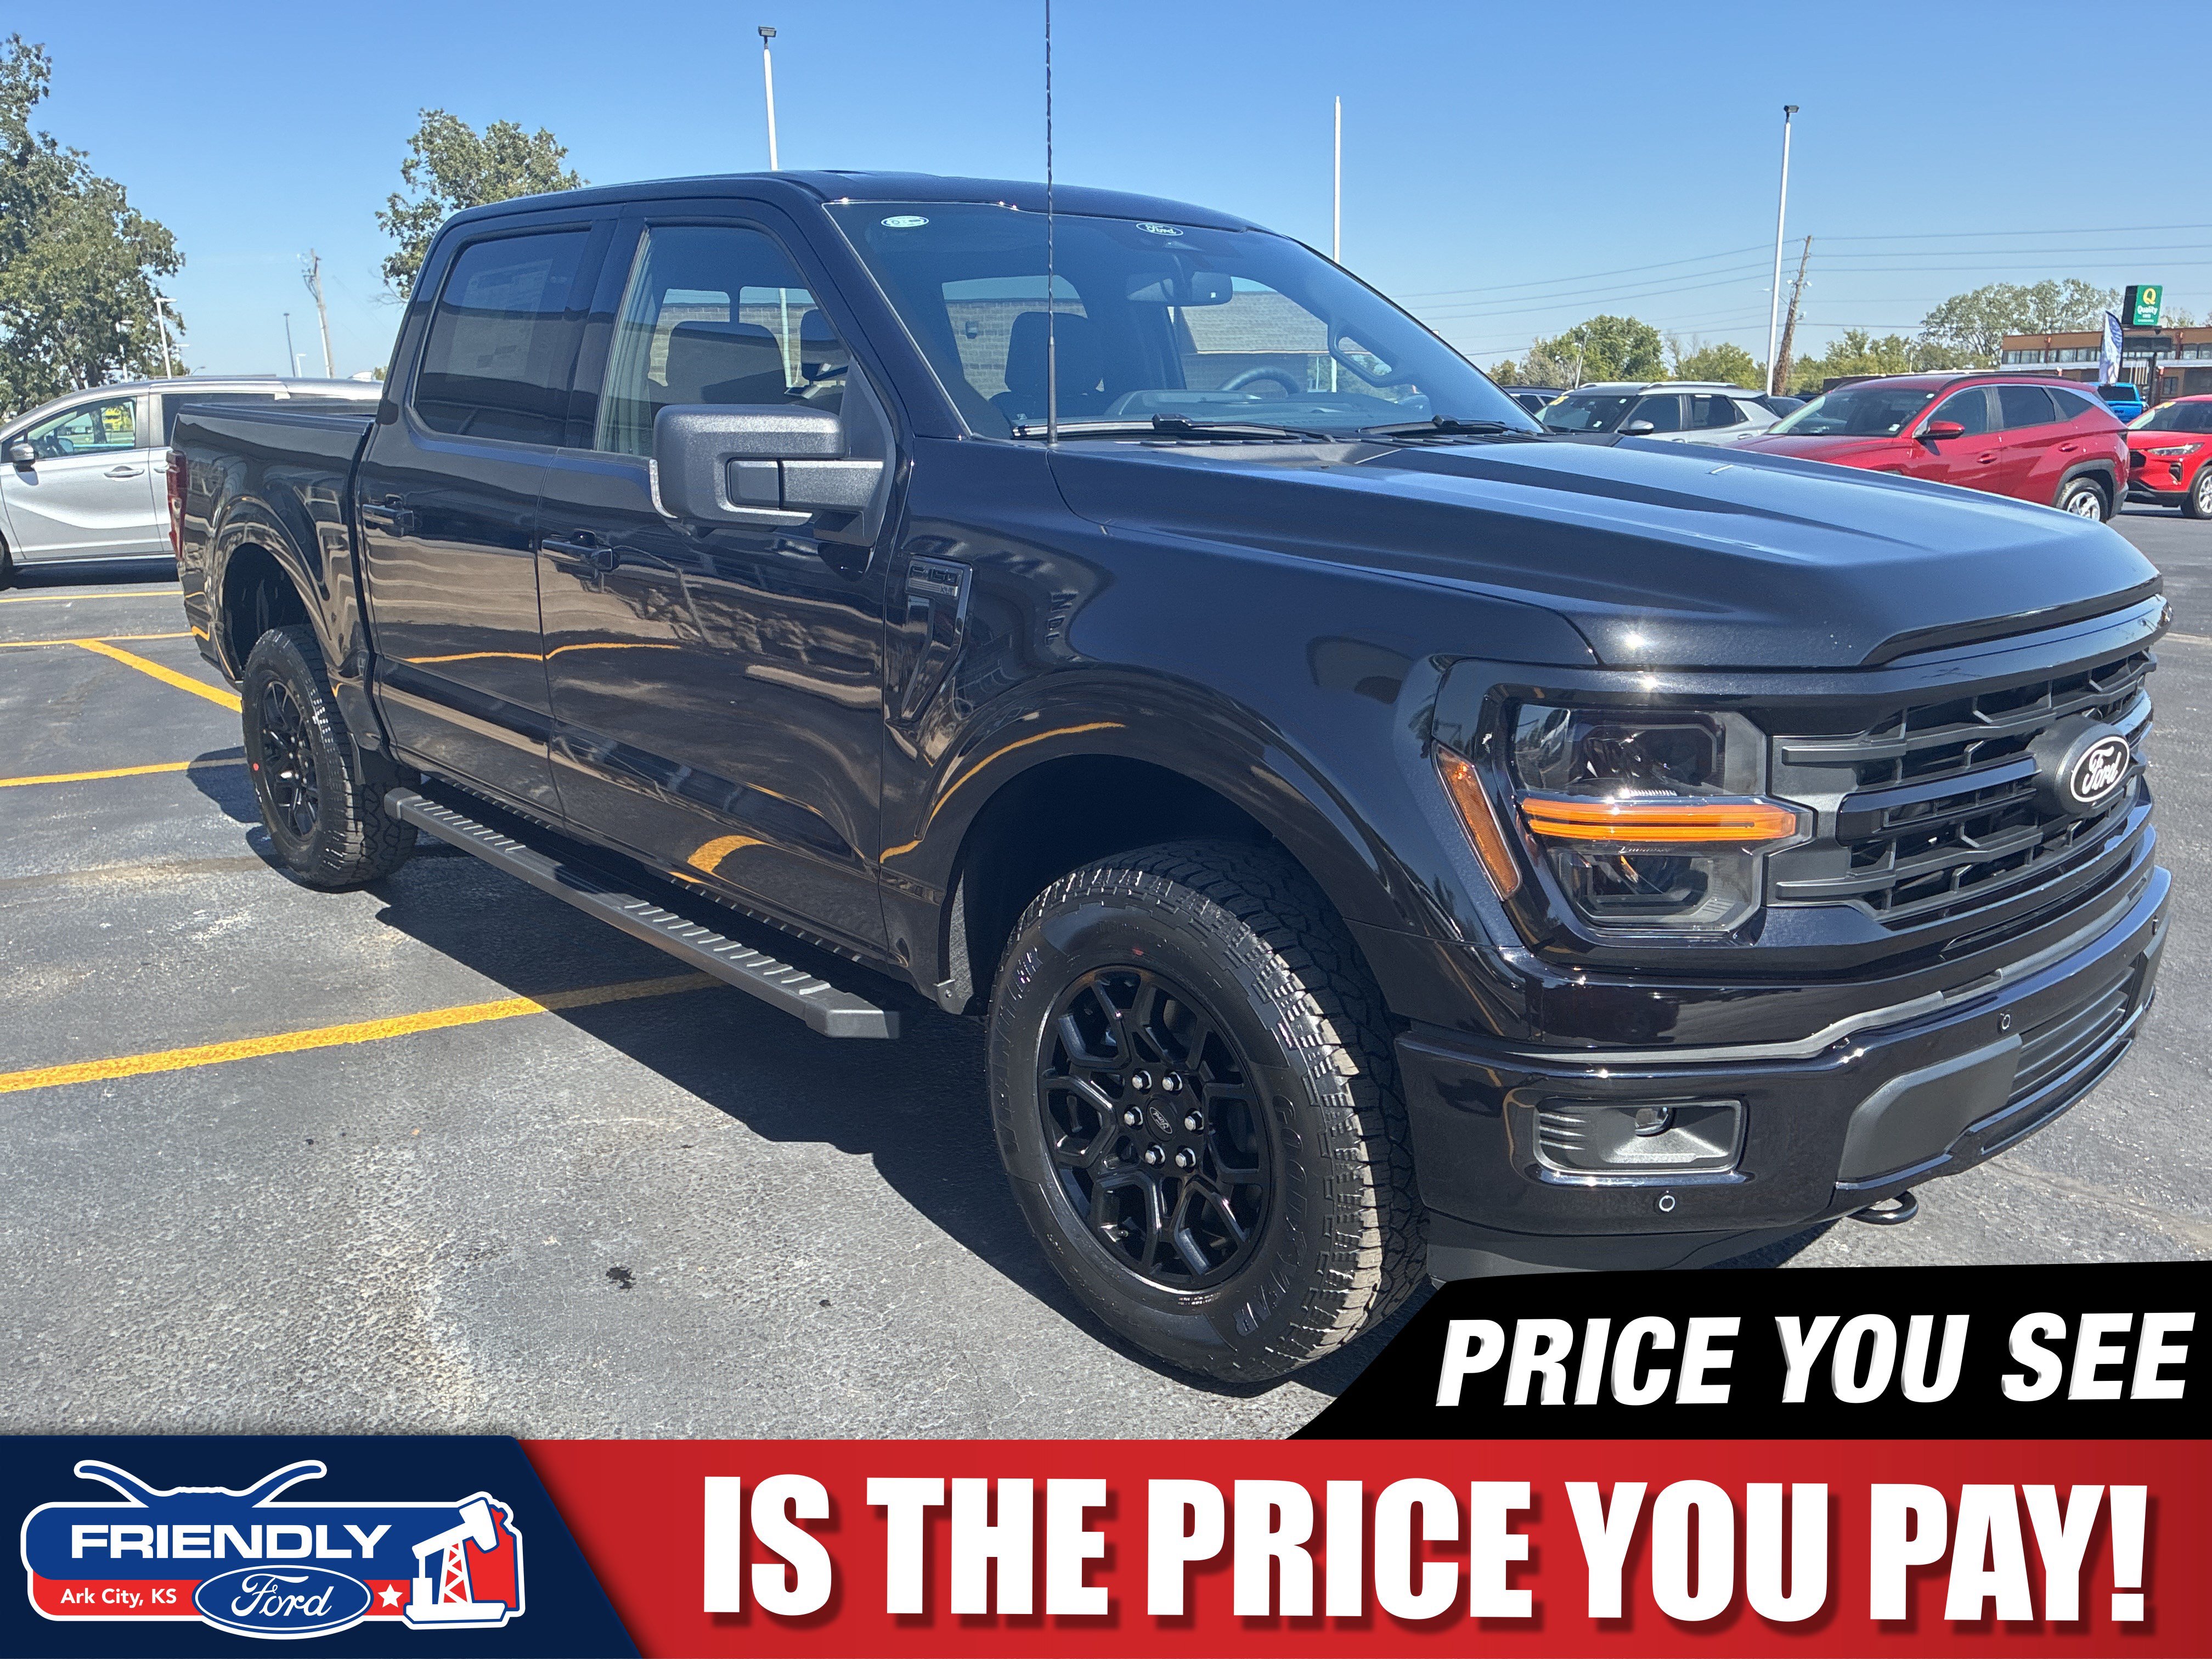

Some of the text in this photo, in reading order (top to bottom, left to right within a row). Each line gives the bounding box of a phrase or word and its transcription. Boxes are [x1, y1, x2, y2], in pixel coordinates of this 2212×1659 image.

[1145, 224, 1177, 234] Ford
[2143, 288, 2156, 304] Q
[2137, 305, 2158, 315] Quality
[2082, 746, 2122, 794] Ford
[1152, 1111, 1169, 1129] Ford
[1234, 1094, 1307, 1336] GOODYEAR
